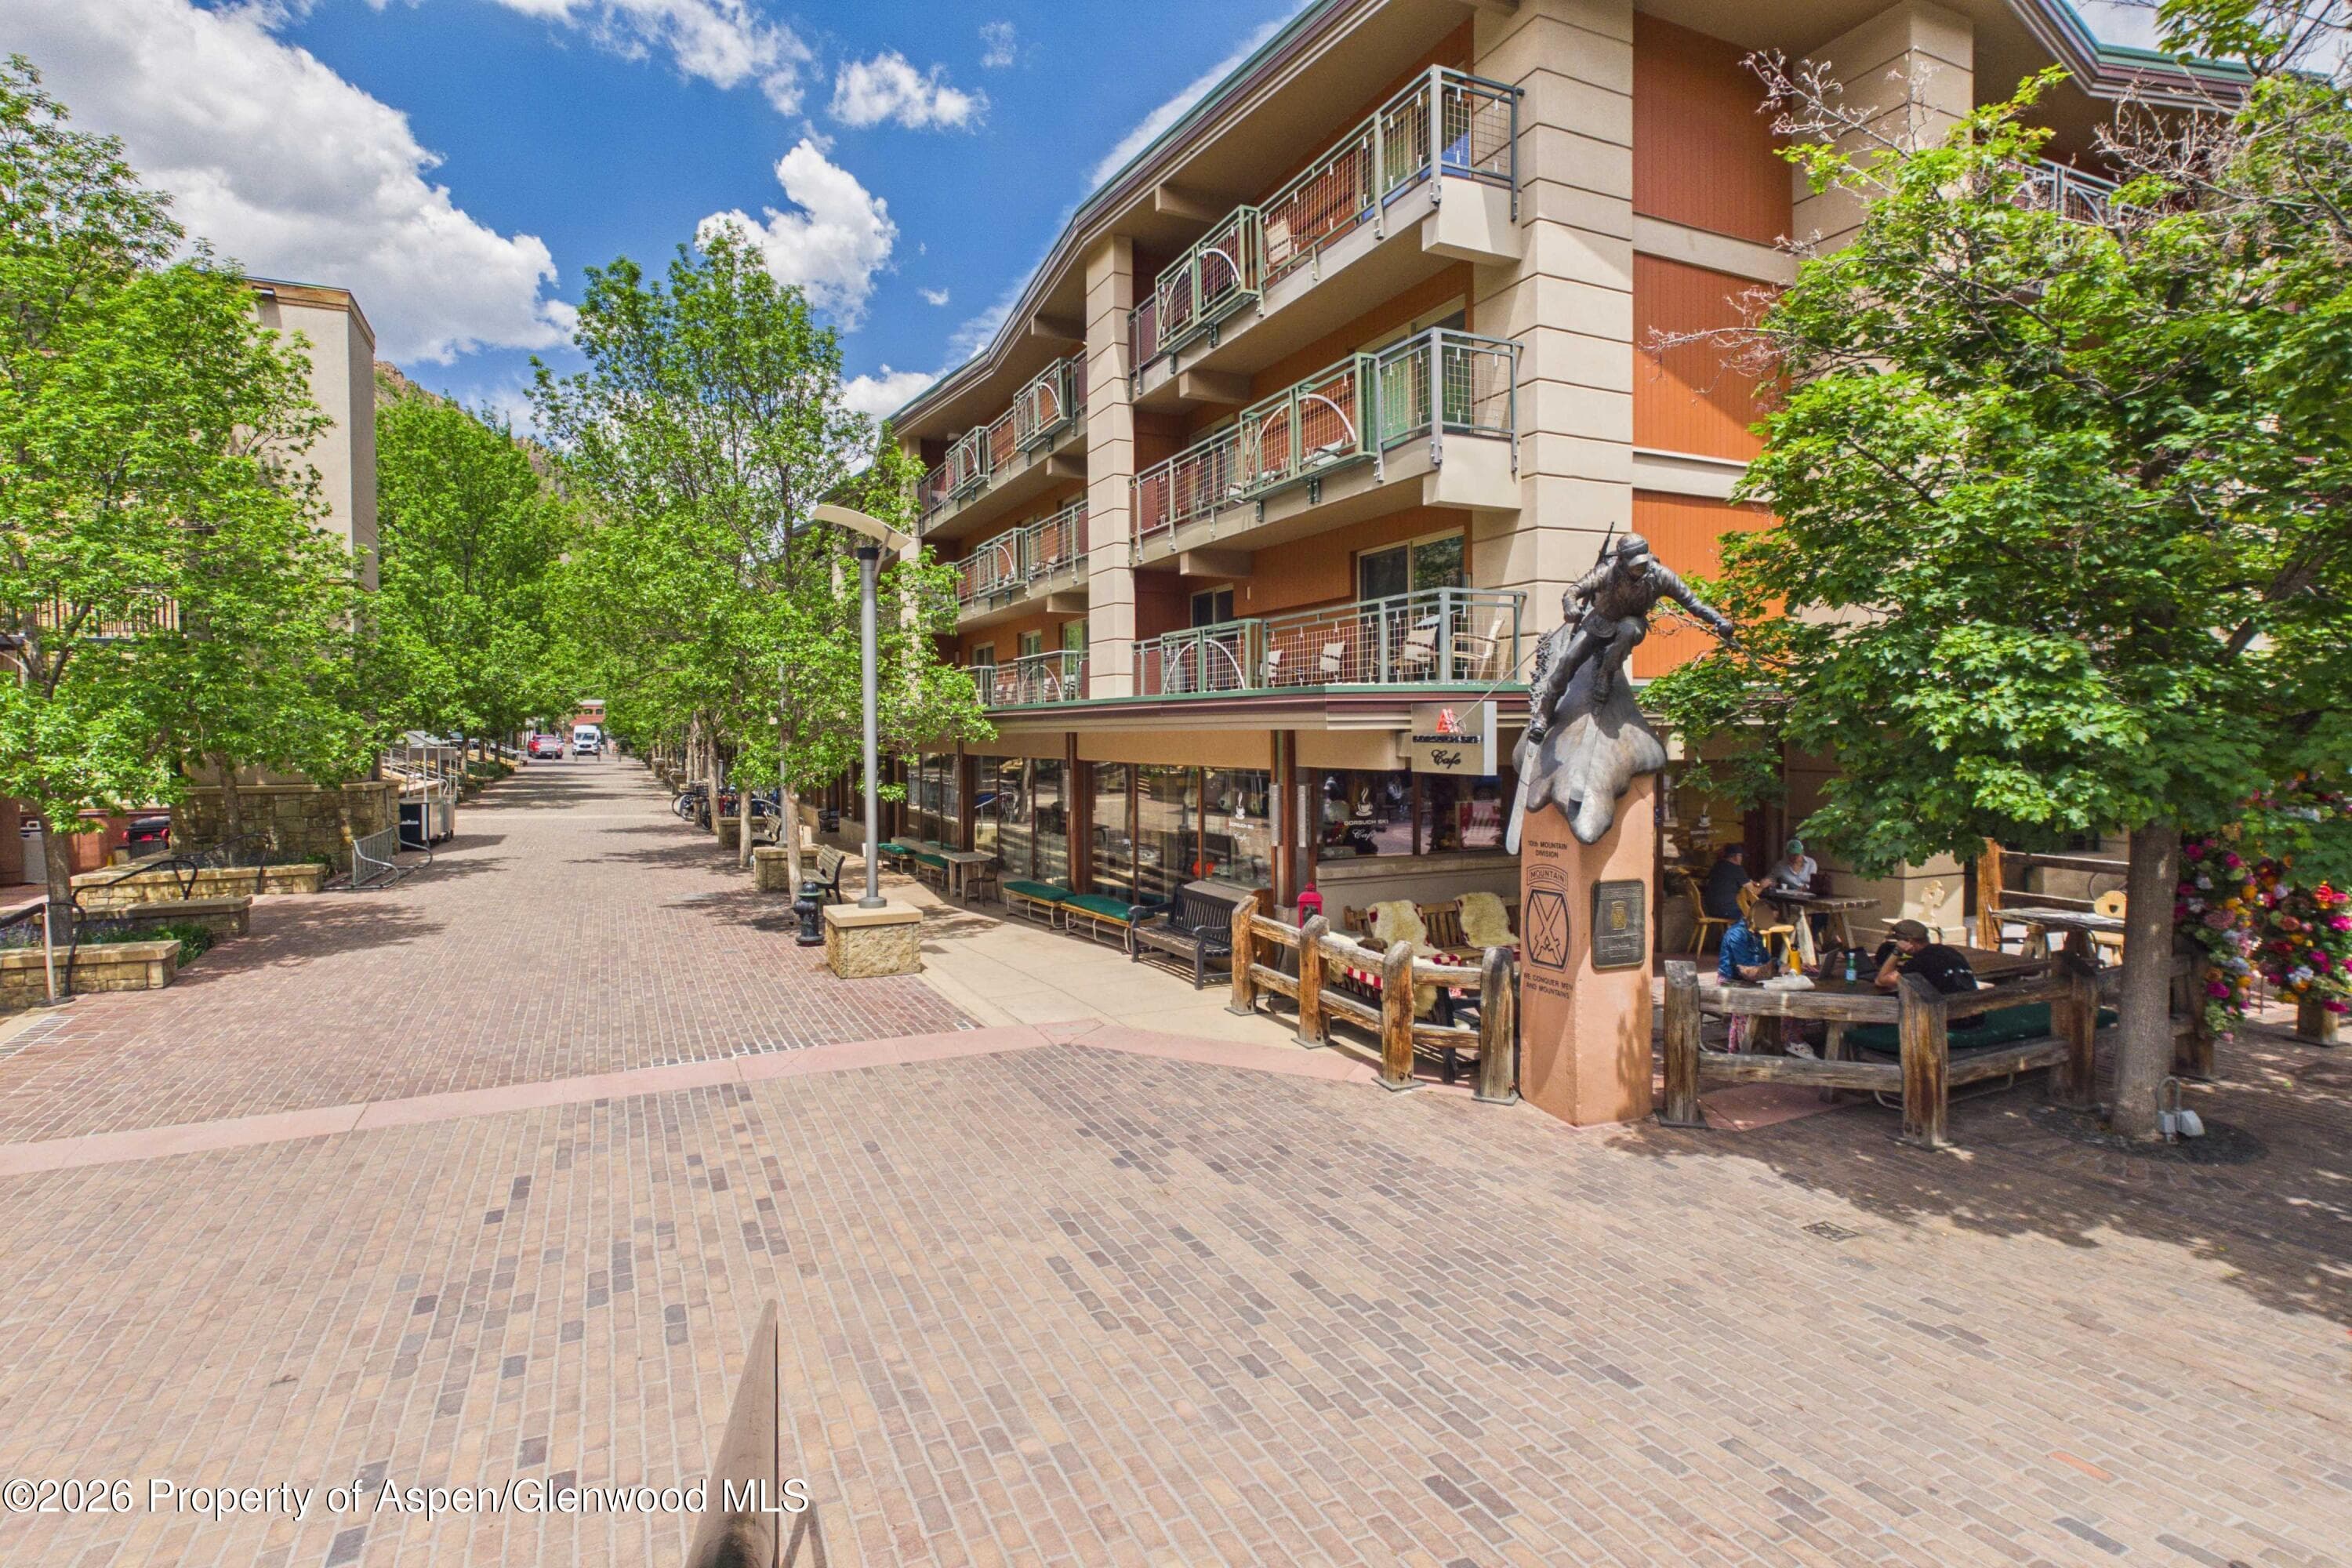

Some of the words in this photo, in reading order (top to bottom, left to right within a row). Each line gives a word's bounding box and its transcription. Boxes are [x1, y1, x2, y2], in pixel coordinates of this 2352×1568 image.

[1540, 841, 1567, 850] MOUNTAIN
[1535, 849, 1559, 858] DIVISION
[1530, 869, 1565, 883] MOUNTAIN
[1533, 975, 1559, 987] CONQUER
[1526, 982, 1537, 990] AND
[1539, 985, 1570, 999] MOUNTAINS
